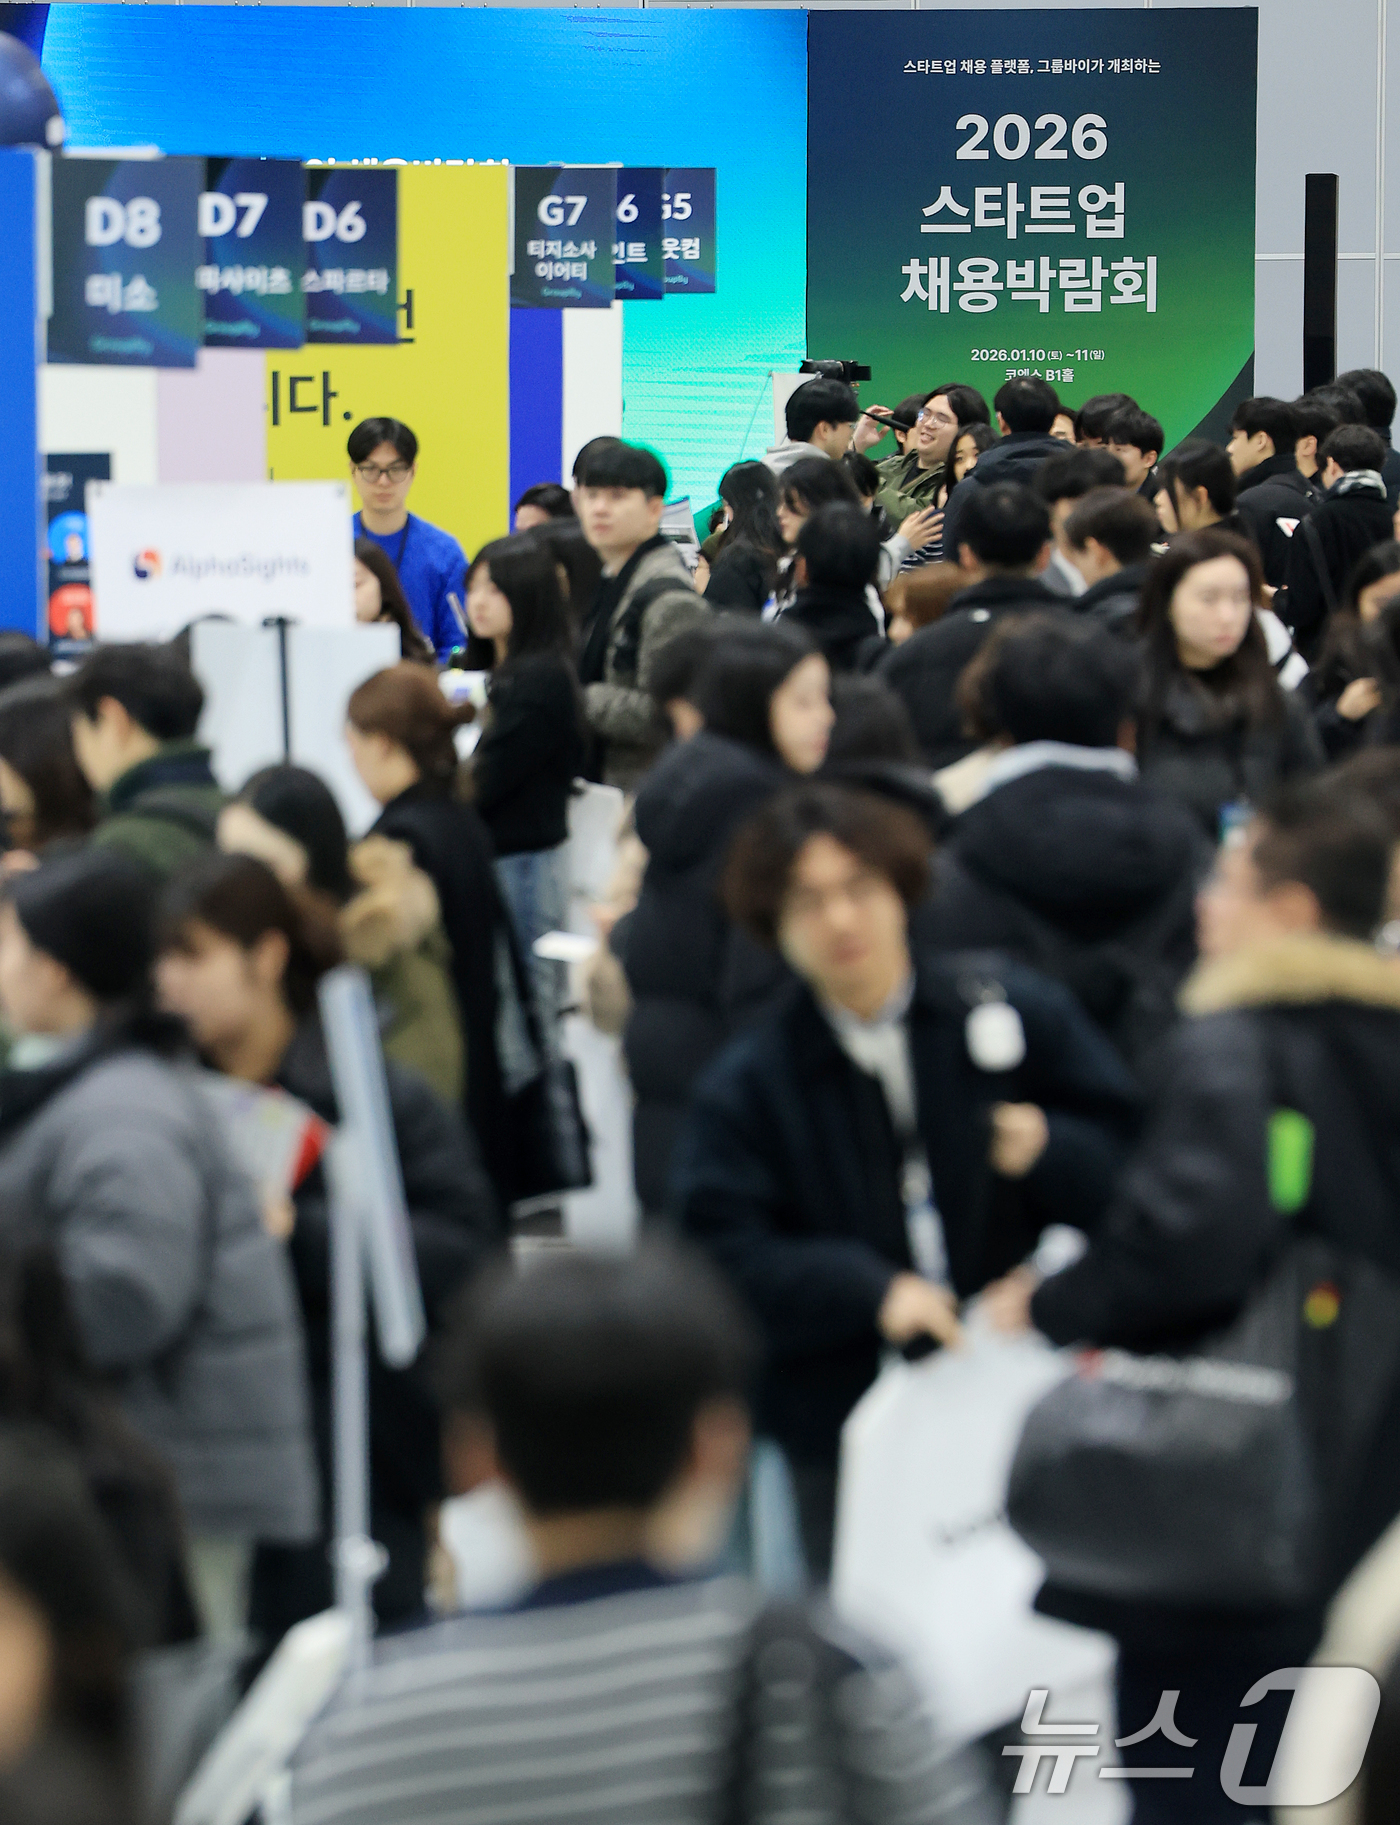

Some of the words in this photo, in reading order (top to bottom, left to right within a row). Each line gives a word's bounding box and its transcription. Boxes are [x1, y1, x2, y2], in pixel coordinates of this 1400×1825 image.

[903, 59, 957, 75] 스타트업
[960, 59, 987, 74] 채용
[990, 59, 1034, 75] 플랫폼,
[1037, 59, 1105, 74] 그룹바이가
[1107, 59, 1161, 74] 개최하는
[955, 113, 1108, 160] 2026
[85, 196, 162, 248] D8
[198, 192, 268, 238] D7
[302, 200, 367, 243] D6
[537, 195, 587, 226] G7
[617, 194, 638, 223] 6
[920, 182, 1125, 239] 스타트업
[526, 239, 597, 259] 티지소사
[661, 237, 700, 260] 웃컴
[534, 260, 587, 281] 이어티
[900, 256, 1157, 313] 채용박람회
[85, 272, 159, 315] 미소
[1045, 368, 1075, 382] B1홀
